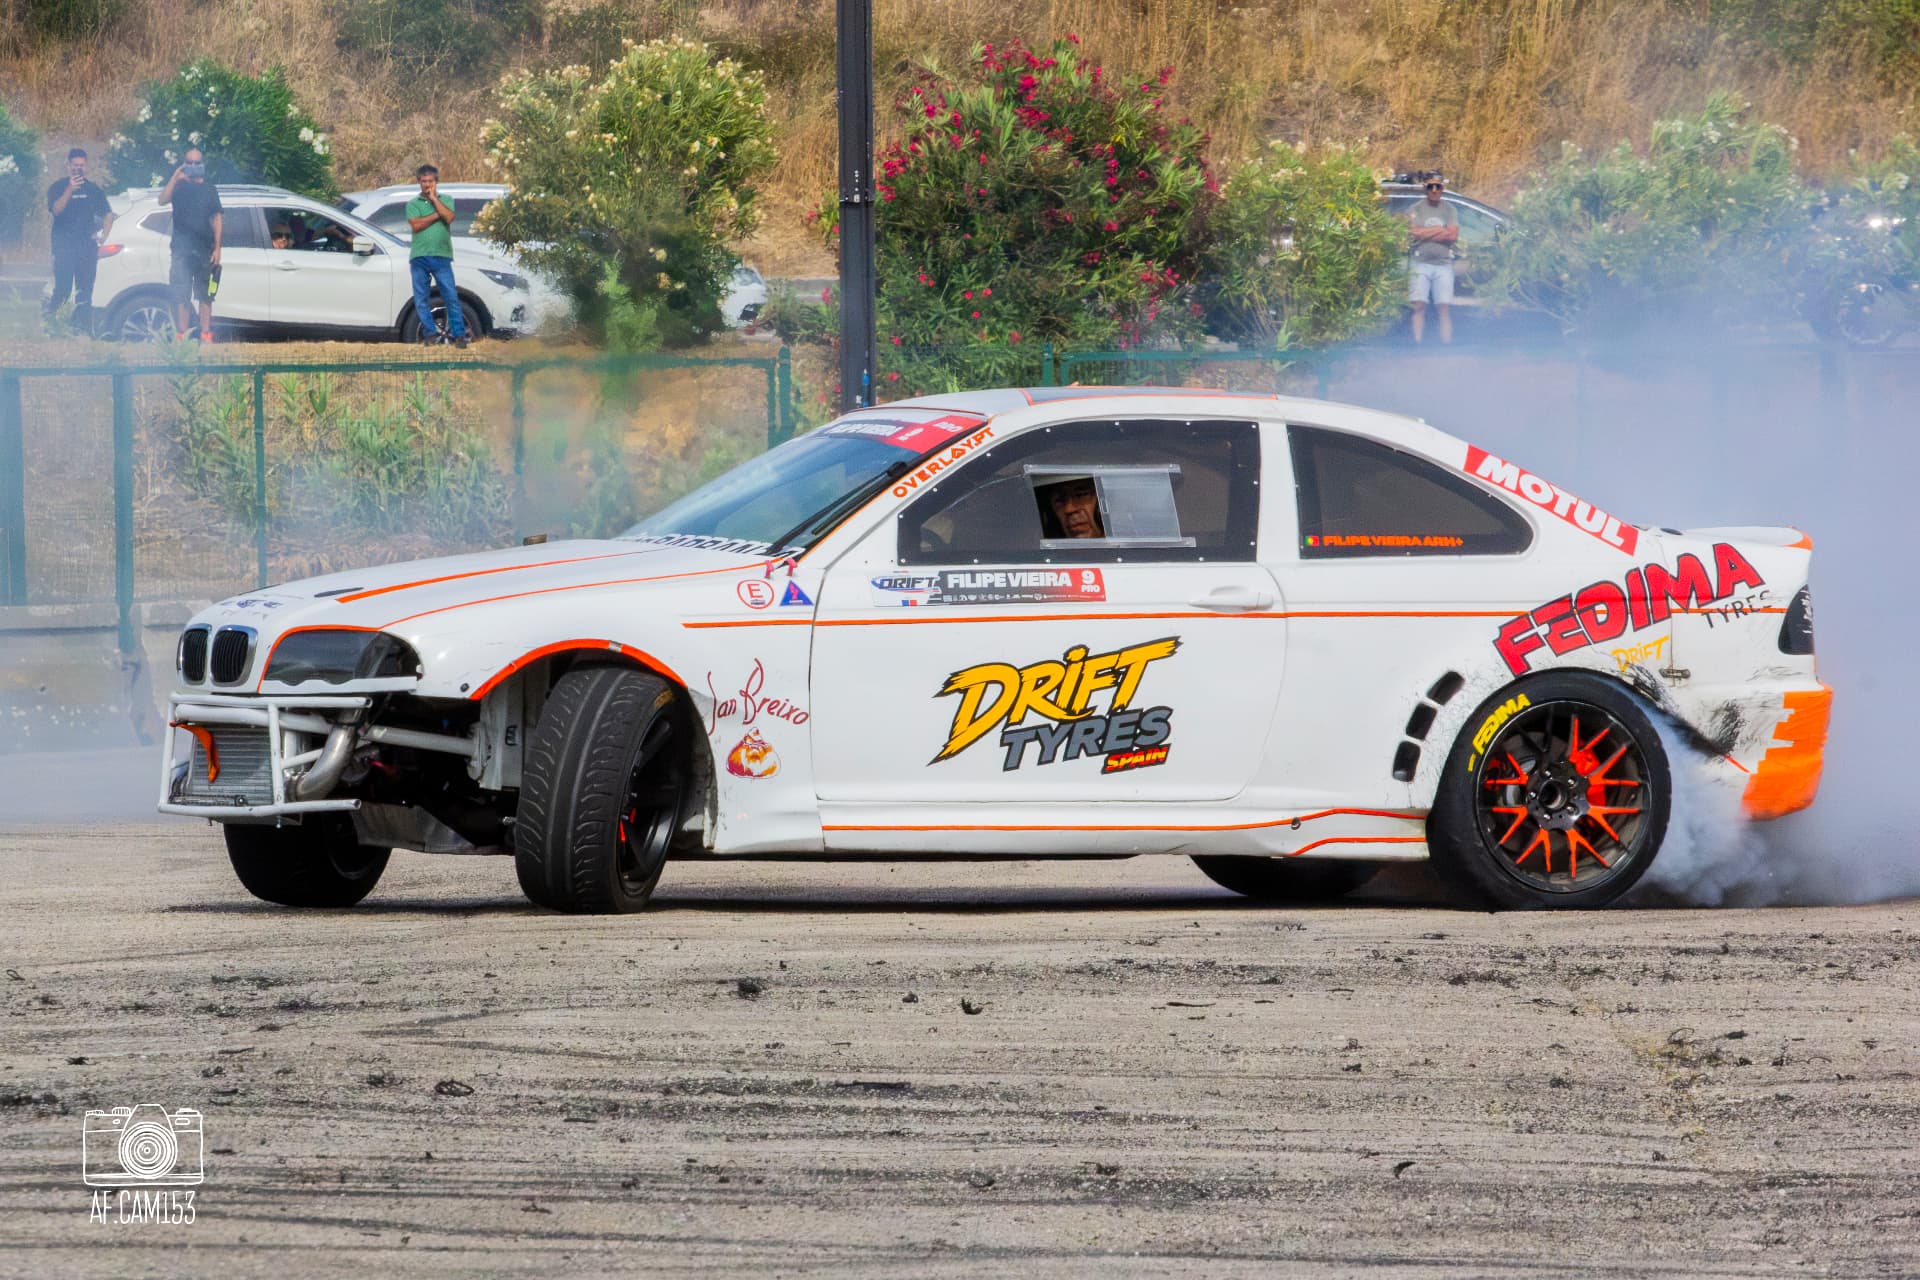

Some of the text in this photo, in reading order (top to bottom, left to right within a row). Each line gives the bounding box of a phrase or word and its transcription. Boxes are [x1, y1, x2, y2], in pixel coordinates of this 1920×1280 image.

[892, 427, 994, 498] OVERLAY.PT
[1476, 455, 1624, 547] MOTUL
[1323, 536, 1370, 547] FILIPE
[1370, 536, 1422, 547] VIEIRA
[873, 575, 940, 592] DRIFT
[947, 571, 1073, 588] FILIPE VIEIRA
[1081, 570, 1096, 585] 9
[1081, 584, 1101, 593] PRO
[747, 583, 763, 598] E
[1493, 543, 1766, 677] FEDIMA
[1472, 692, 1532, 757] FEDIMA
[1000, 705, 1174, 772] TYRES
[1101, 744, 1171, 774] SPAIN
